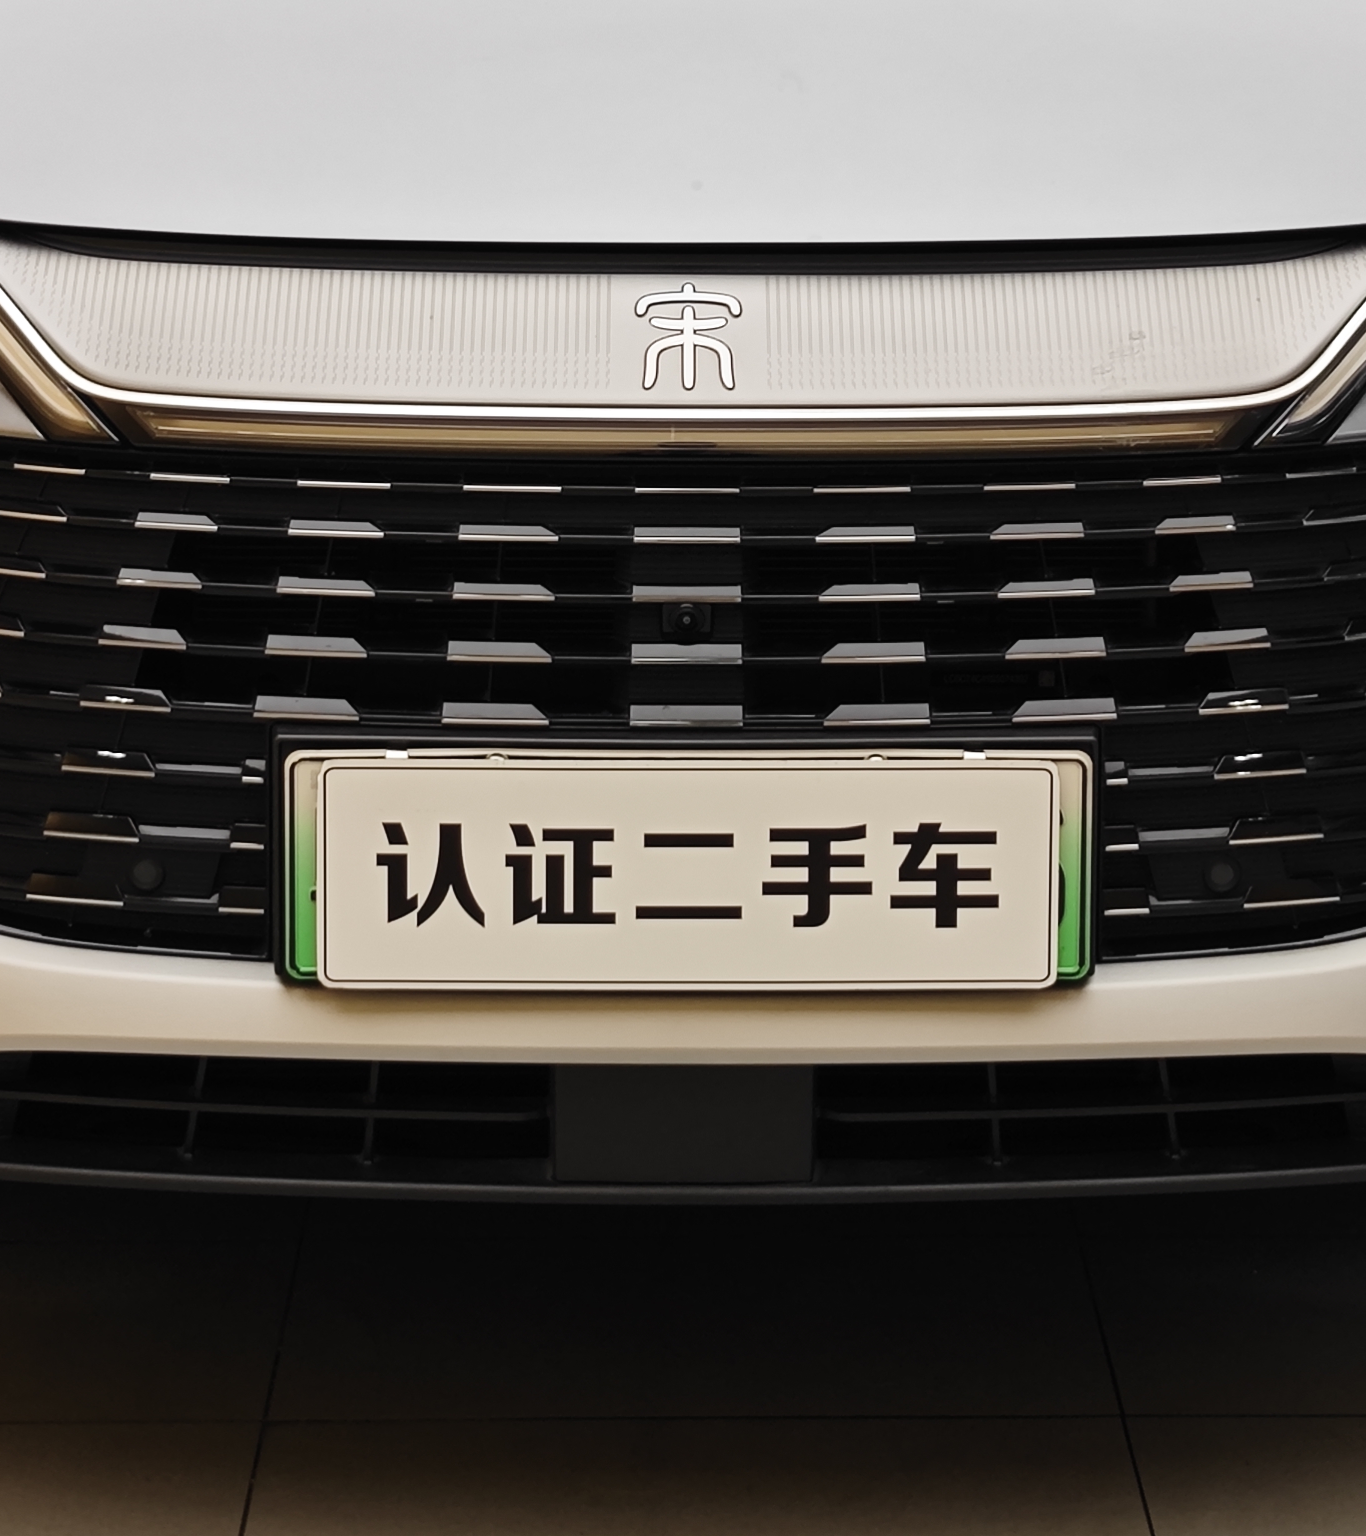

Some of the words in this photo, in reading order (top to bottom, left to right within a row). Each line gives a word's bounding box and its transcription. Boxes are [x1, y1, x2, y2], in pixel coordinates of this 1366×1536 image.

[376, 821, 1000, 930] 认证二手车
